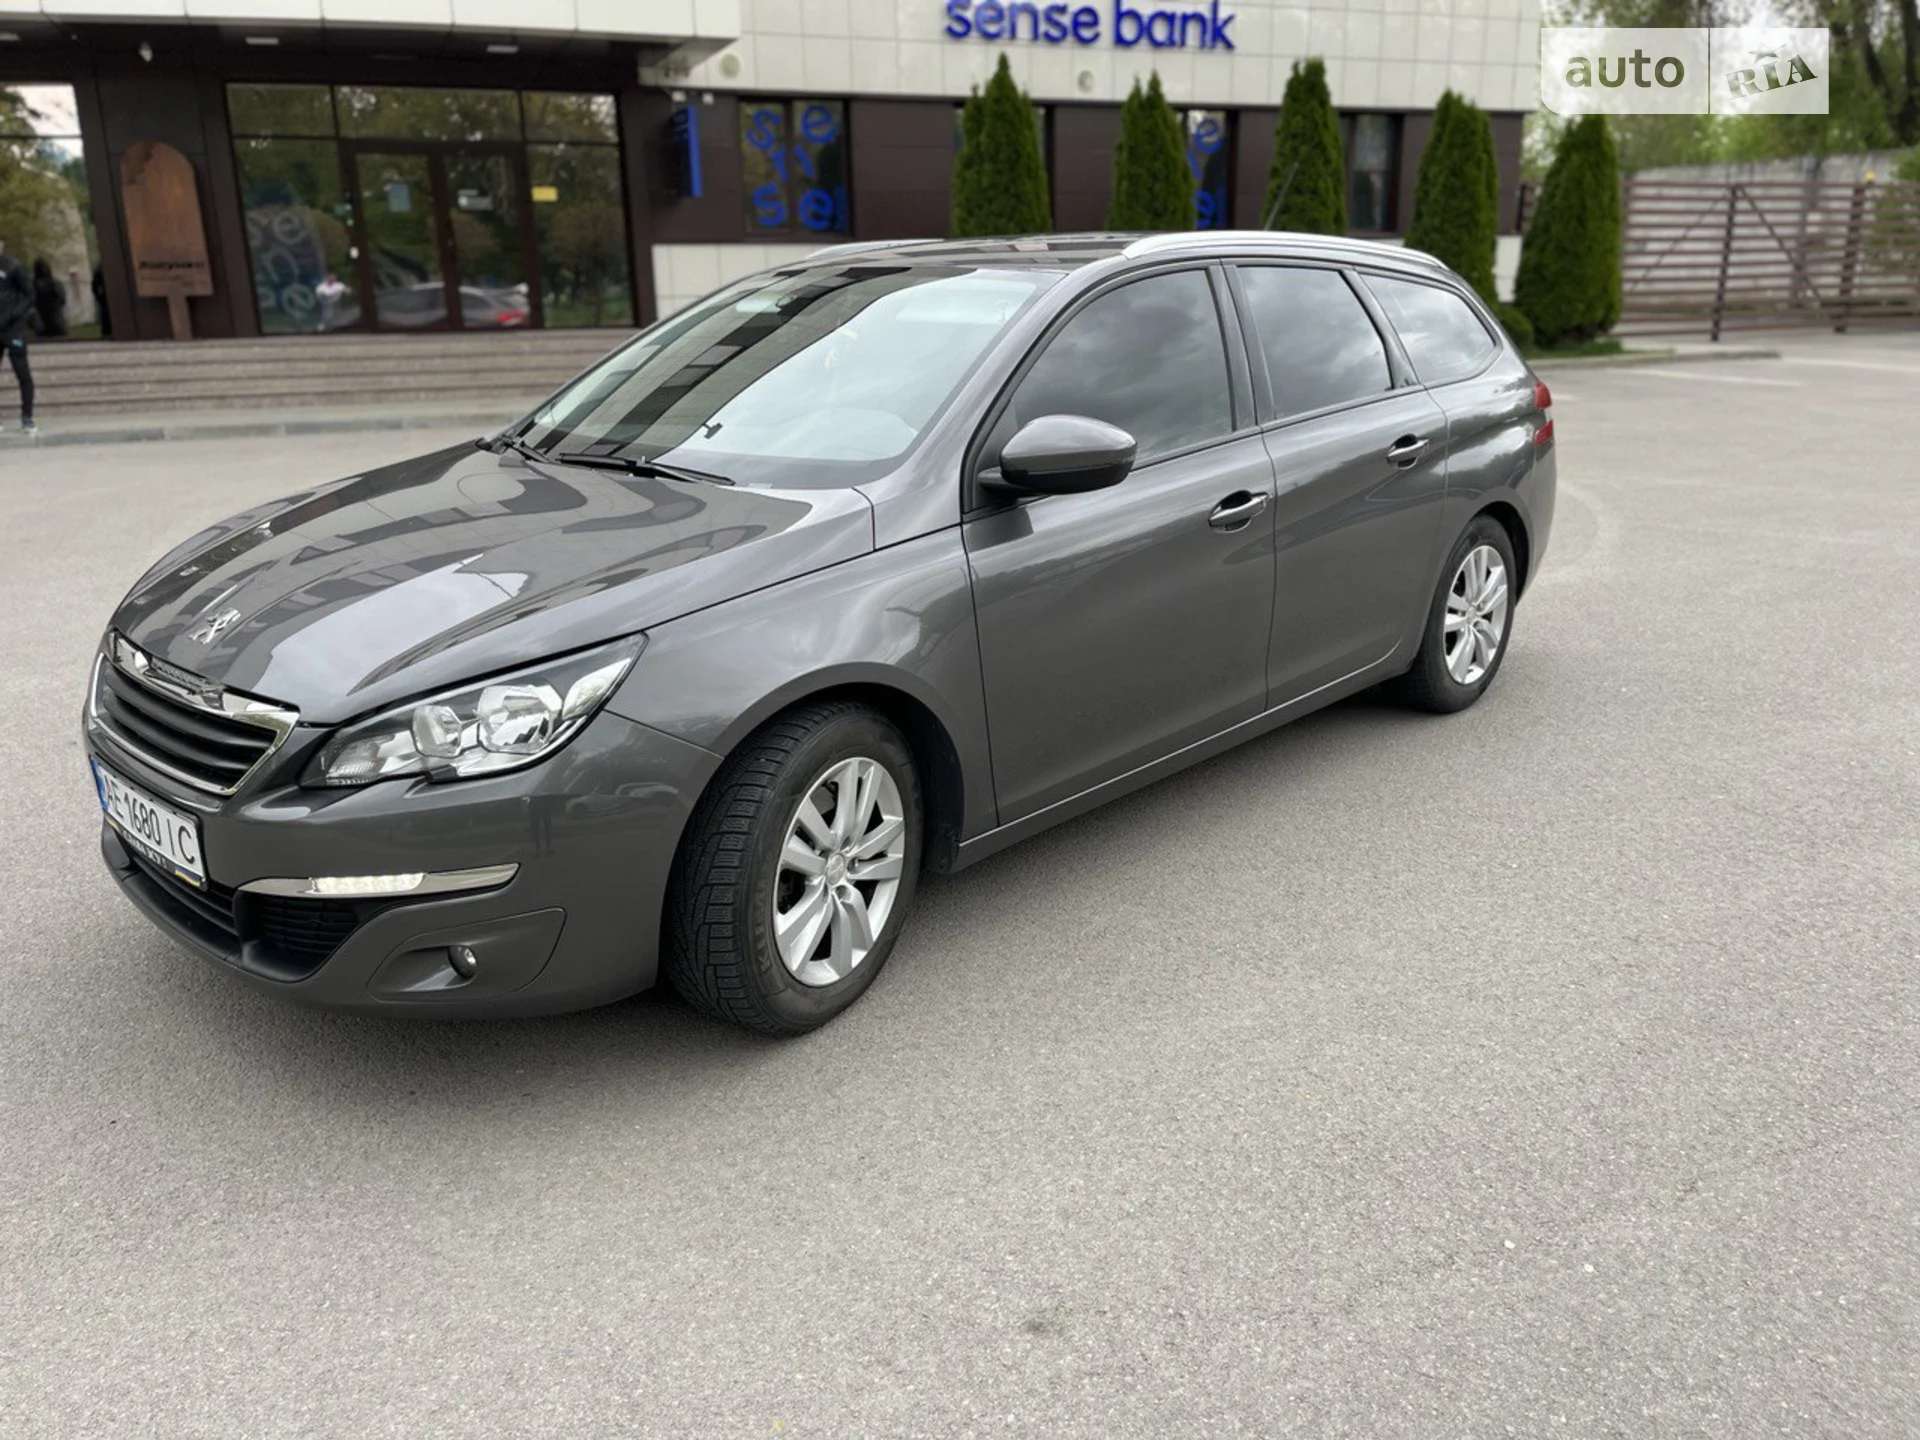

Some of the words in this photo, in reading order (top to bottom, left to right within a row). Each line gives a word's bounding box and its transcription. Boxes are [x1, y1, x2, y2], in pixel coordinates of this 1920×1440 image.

[945, 0, 1101, 44] sense
[1114, 0, 1236, 50] bank
[124, 792, 162, 846] 1680
[166, 818, 195, 864] IC
